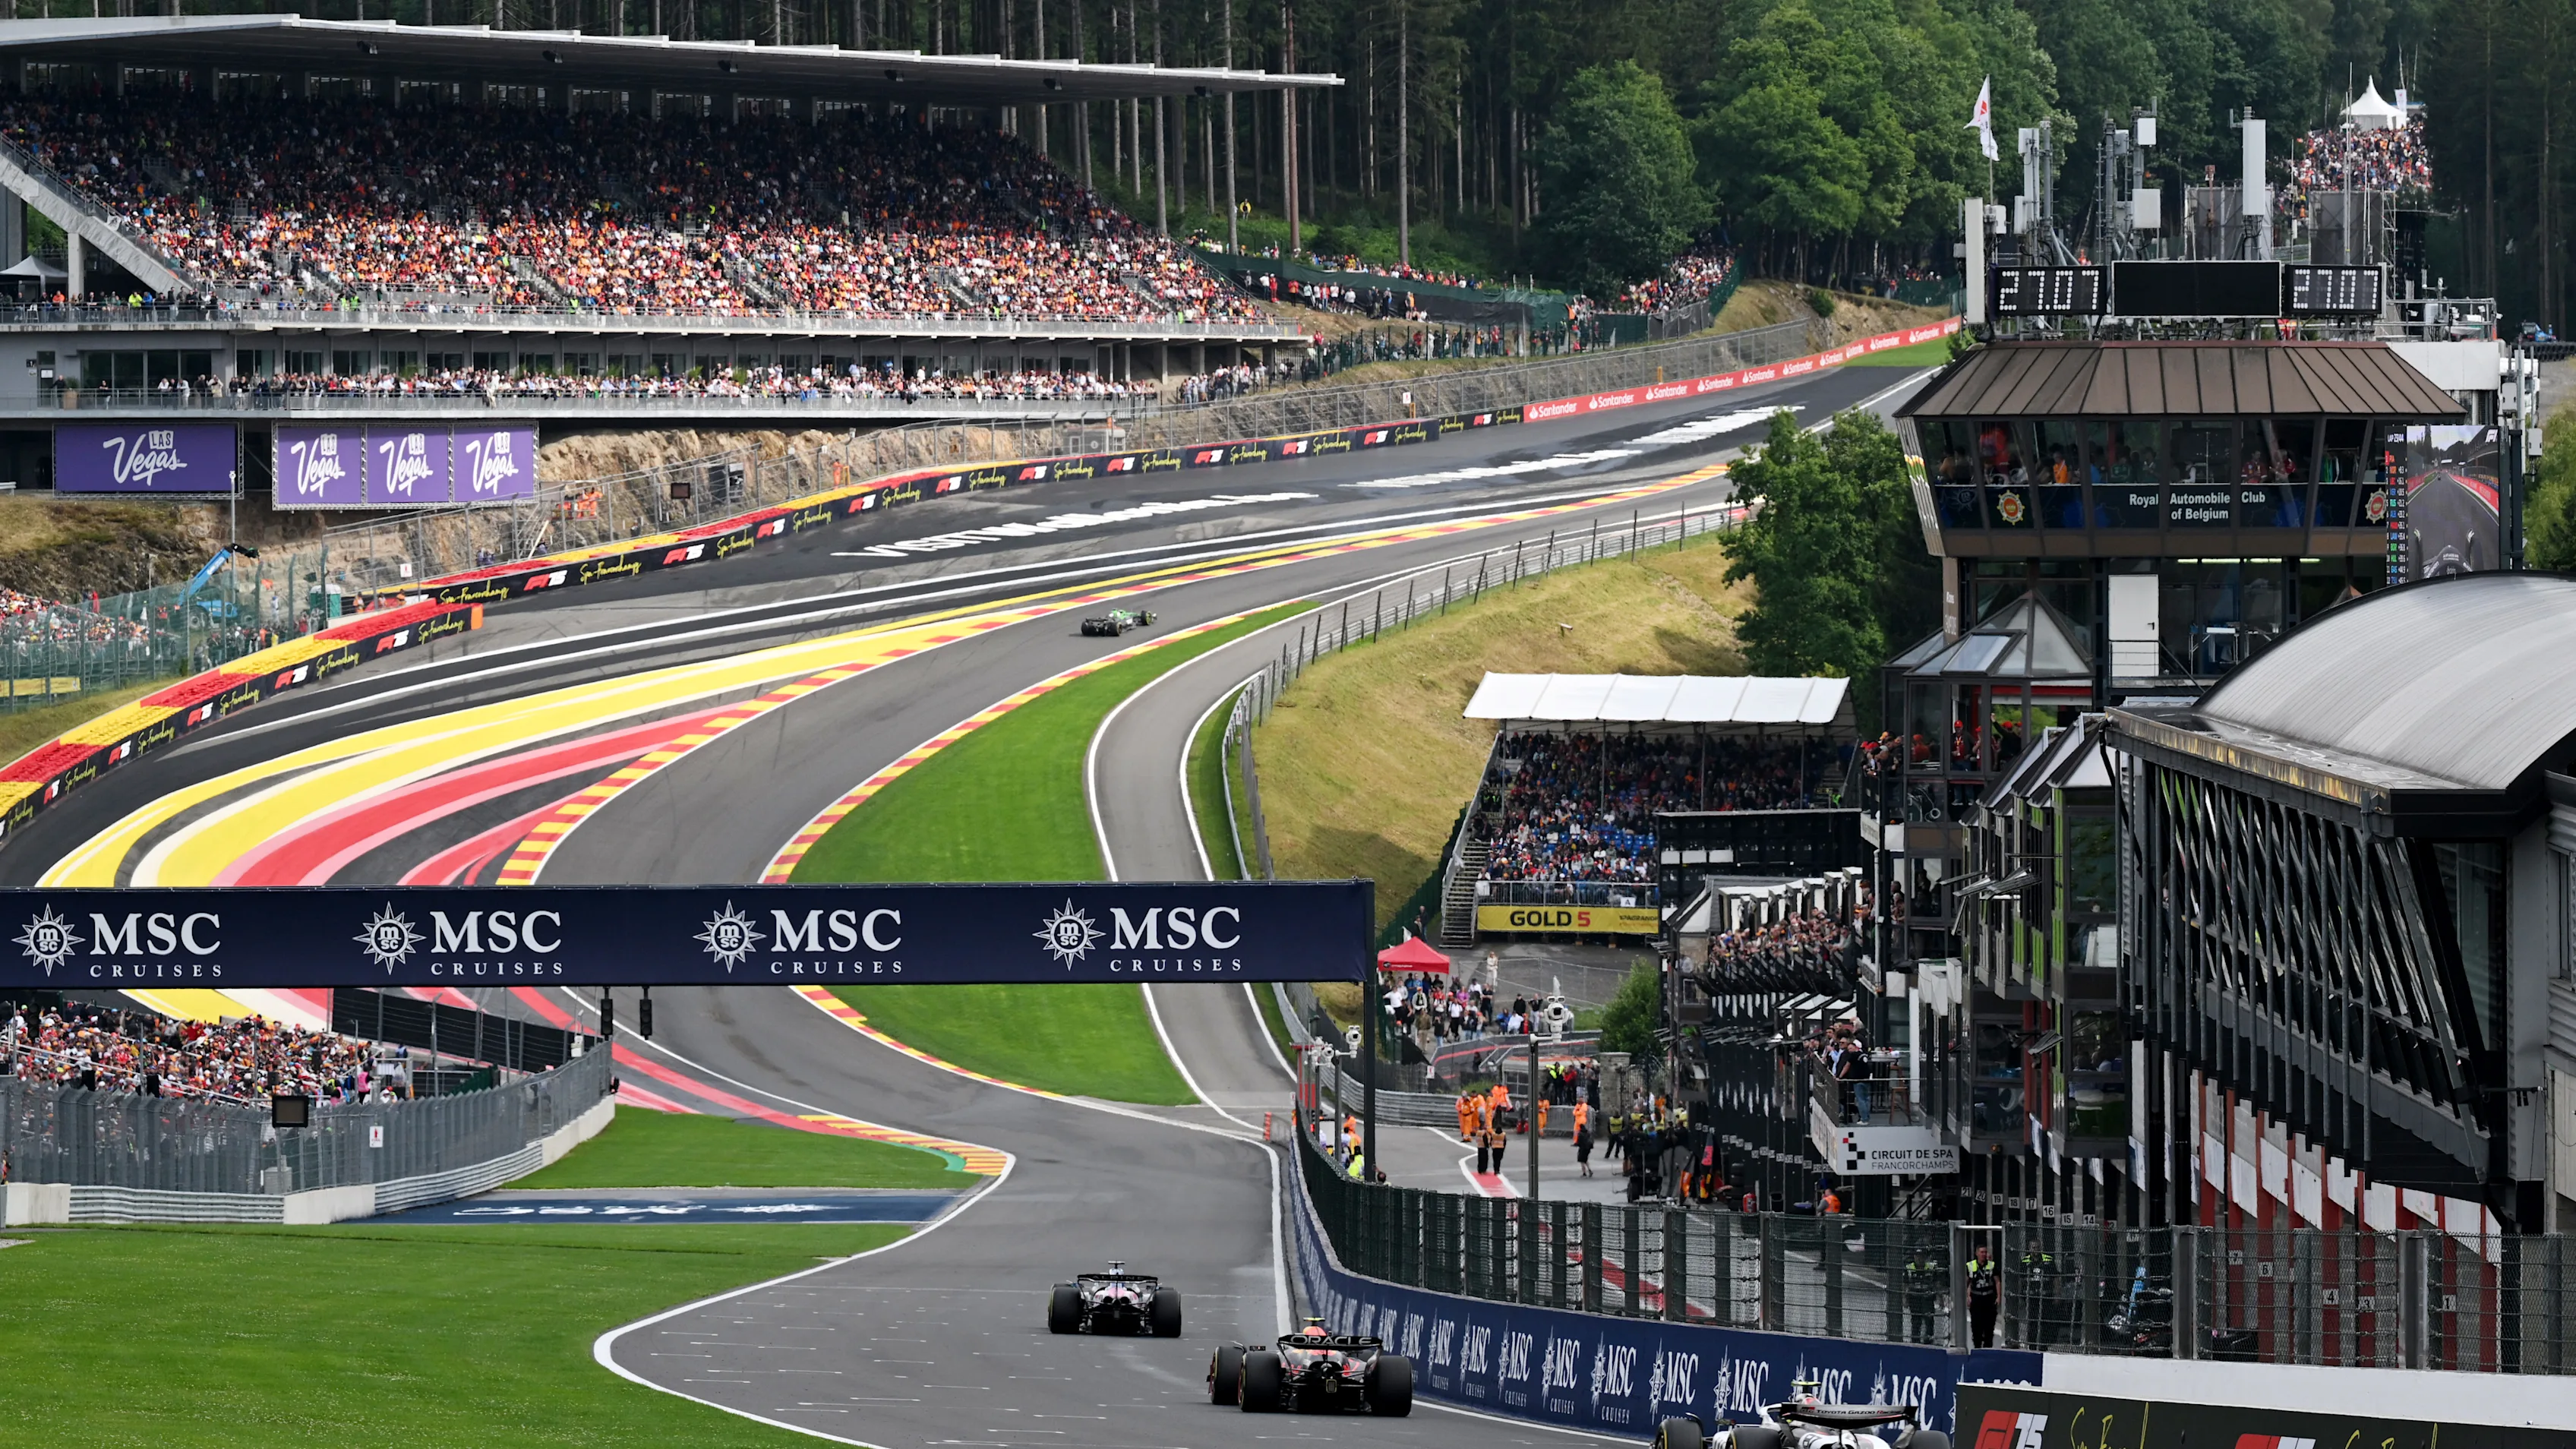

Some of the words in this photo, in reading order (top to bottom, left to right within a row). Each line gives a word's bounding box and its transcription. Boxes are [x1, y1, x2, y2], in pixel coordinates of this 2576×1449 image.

[1999, 270, 2100, 311] 27.07
[2293, 269, 2379, 311] 27.07
[1653, 384, 1688, 398] Santander
[1704, 377, 1735, 391] Santander
[1598, 393, 1635, 409] Santander
[1538, 402, 1577, 418] Santander
[150, 432, 172, 447] LAS
[103, 433, 188, 486] Vegas
[291, 437, 346, 497] Vegas
[380, 437, 434, 497] Vegas
[466, 436, 519, 494] Vegas
[2129, 494, 2159, 508] Royal
[2170, 492, 2230, 505] Automobile
[2241, 491, 2266, 504] Club
[2171, 507, 2183, 520] of
[2185, 507, 2229, 522] Belgium
[1510, 911, 1572, 927] GOLD
[1577, 911, 1591, 927] 5
[90, 912, 221, 955] MSC
[430, 910, 562, 954] MSC
[770, 908, 902, 952] MSC
[1110, 906, 1242, 950] MSC
[90, 964, 222, 978] CRUISES
[431, 962, 563, 976] CRUISES
[771, 961, 903, 974] CRUISES
[1110, 958, 1242, 972] CRUISES
[1872, 1151, 1912, 1160] CIRCUIT
[1916, 1150, 1930, 1159] DE
[1933, 1149, 1953, 1158] SPA
[1872, 1161, 1954, 1170] FRANCORCHAMPS
[1962, 1188, 1971, 1196] 21
[1994, 1195, 2001, 1204] 19
[2027, 1198, 2035, 1209] 17
[2044, 1207, 2053, 1216] 16
[2063, 1214, 2072, 1223] 15
[2084, 1215, 2094, 1224] 14
[1290, 1336, 1372, 1346] ORACLE
[1406, 1312, 1424, 1359] MSC
[1435, 1319, 1455, 1366] MSC
[1468, 1325, 1491, 1375] MSC
[1507, 1331, 1533, 1381] MSC
[1552, 1338, 1580, 1390] MSC
[1603, 1344, 1637, 1397] MSC
[1663, 1351, 1699, 1405] MSC
[1730, 1359, 1769, 1416] MSC
[1550, 1397, 1574, 1416] CRUISES
[1601, 1406, 1630, 1424] CRUISES
